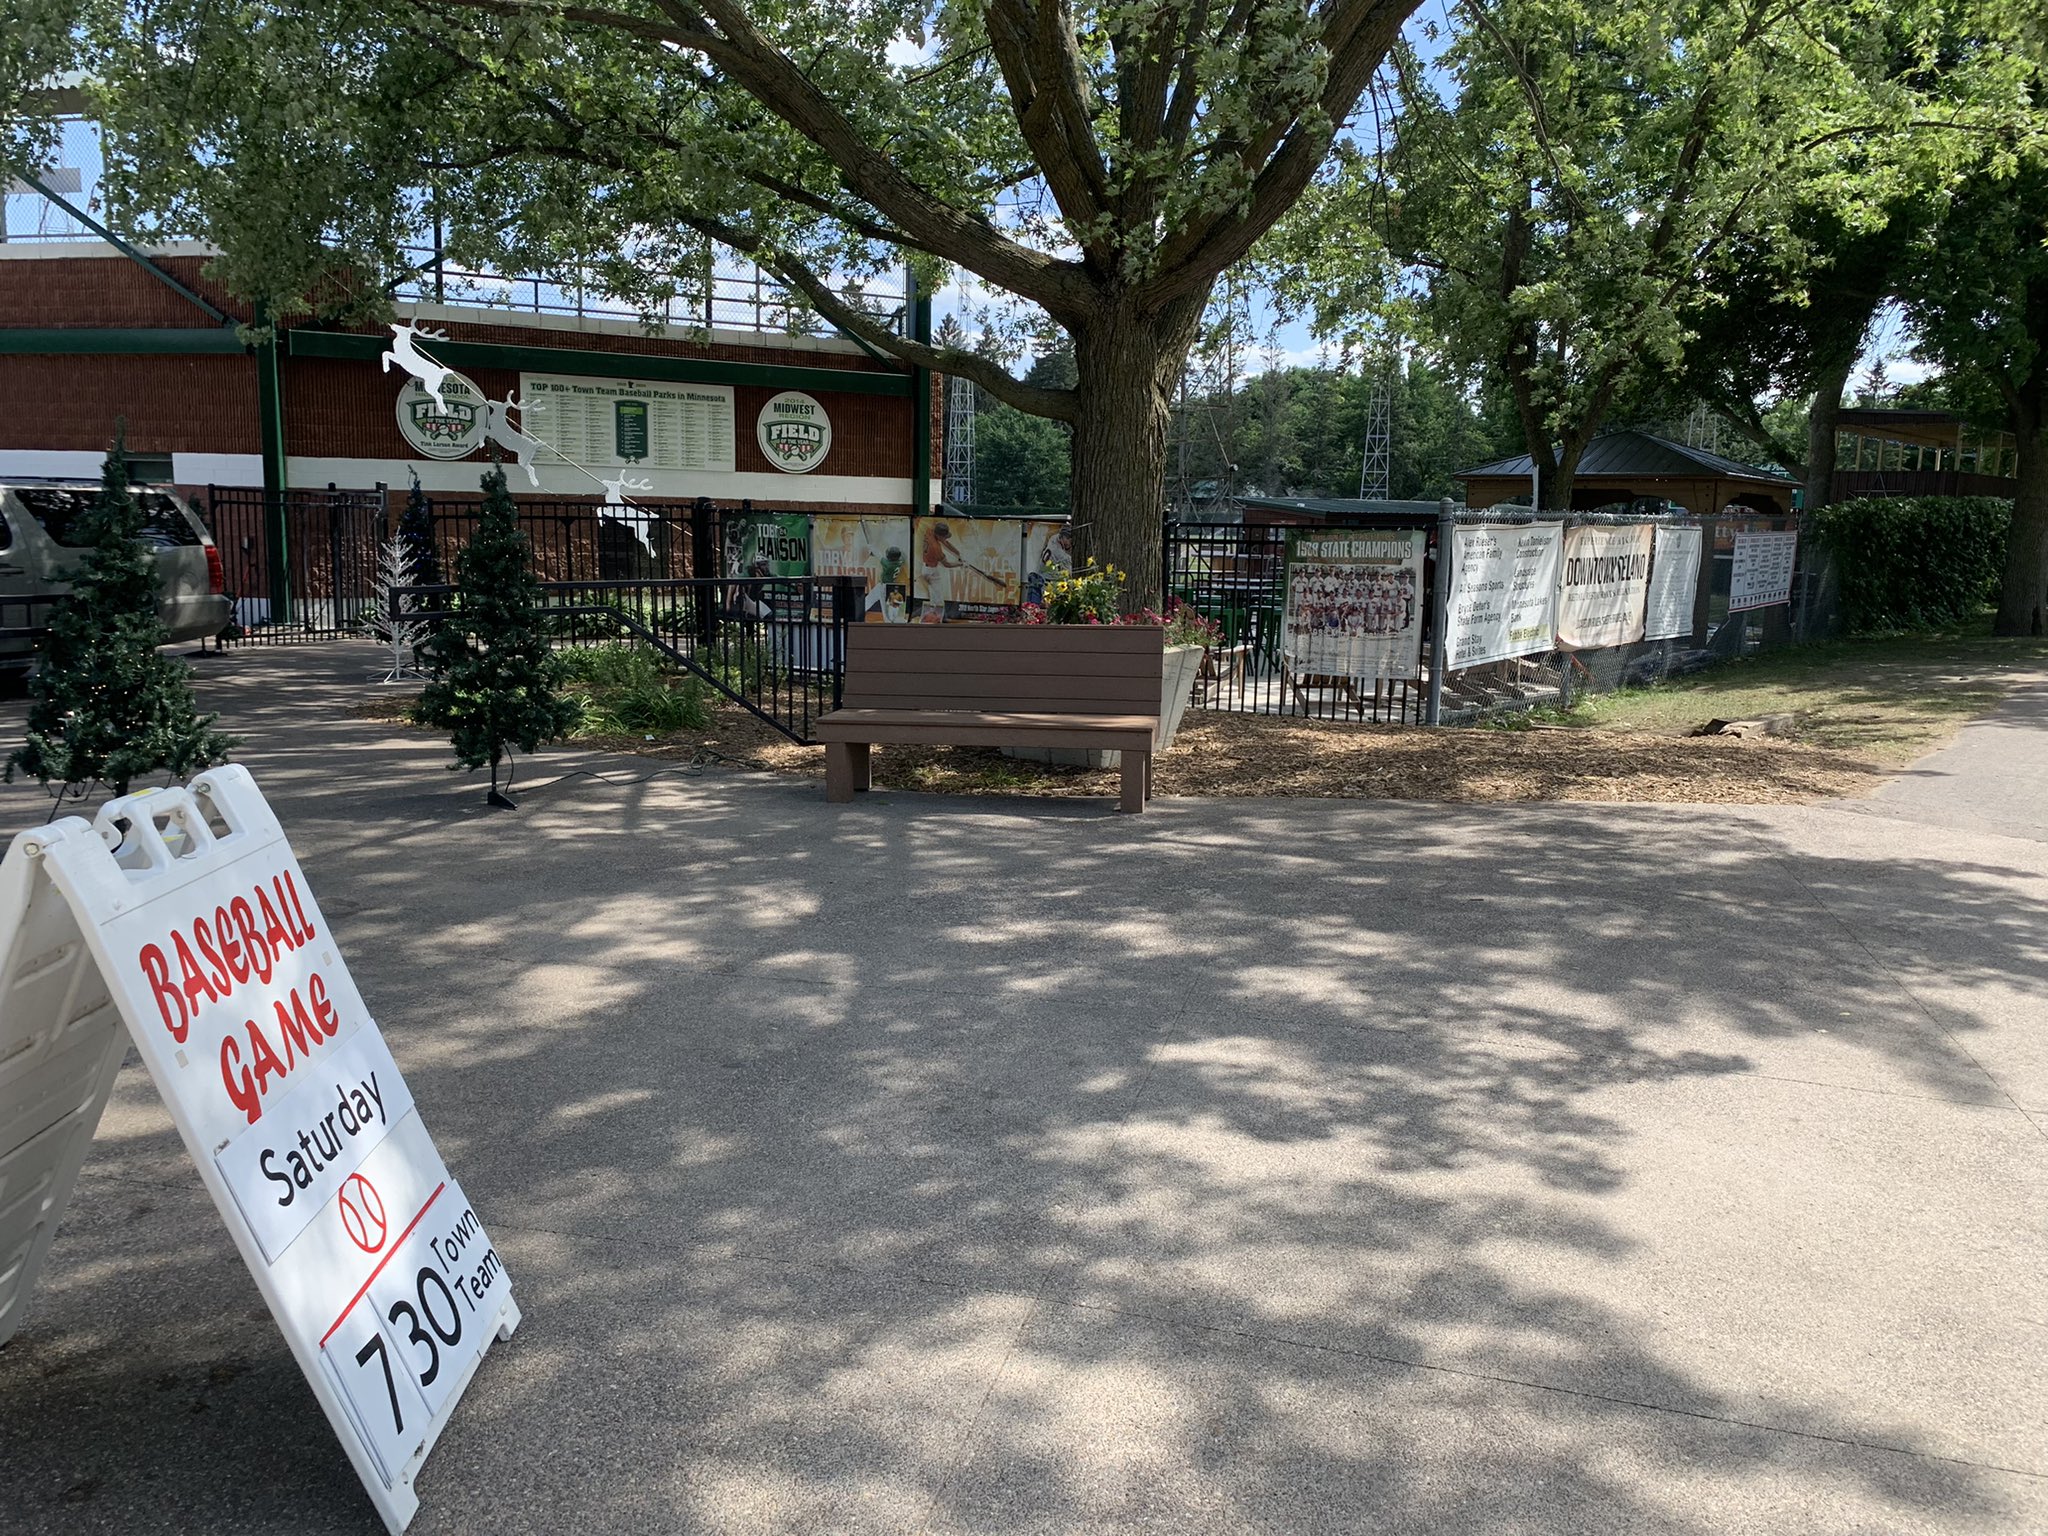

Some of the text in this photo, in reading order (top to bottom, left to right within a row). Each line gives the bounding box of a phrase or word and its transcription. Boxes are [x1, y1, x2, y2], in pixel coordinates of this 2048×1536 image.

[530, 382, 727, 403] TOP 100+ Town Team Baseball Parks in Minnesota
[773, 402, 816, 415] MIDWEST
[771, 423, 820, 442] FIELD
[757, 537, 807, 562] HANSON
[1320, 541, 1350, 558] STATE
[1351, 541, 1412, 559] CHAMPIONS
[1463, 547, 1503, 560] American Family
[1516, 547, 1544, 559] Construction
[1461, 562, 1479, 576] Agency
[1566, 556, 1616, 587] DOWNTOWN
[950, 568, 1017, 605] WOLFE
[1467, 582, 1488, 594] Seasons
[1488, 580, 1505, 593] Sports
[1457, 612, 1501, 627] State Farm Agency
[1456, 633, 1482, 647] Grand Stay
[139, 869, 316, 1044] BASEBALL
[220, 973, 340, 1125] GAME
[259, 1071, 387, 1208] Saturday
[430, 1208, 480, 1275] Town
[454, 1247, 502, 1313] Team
